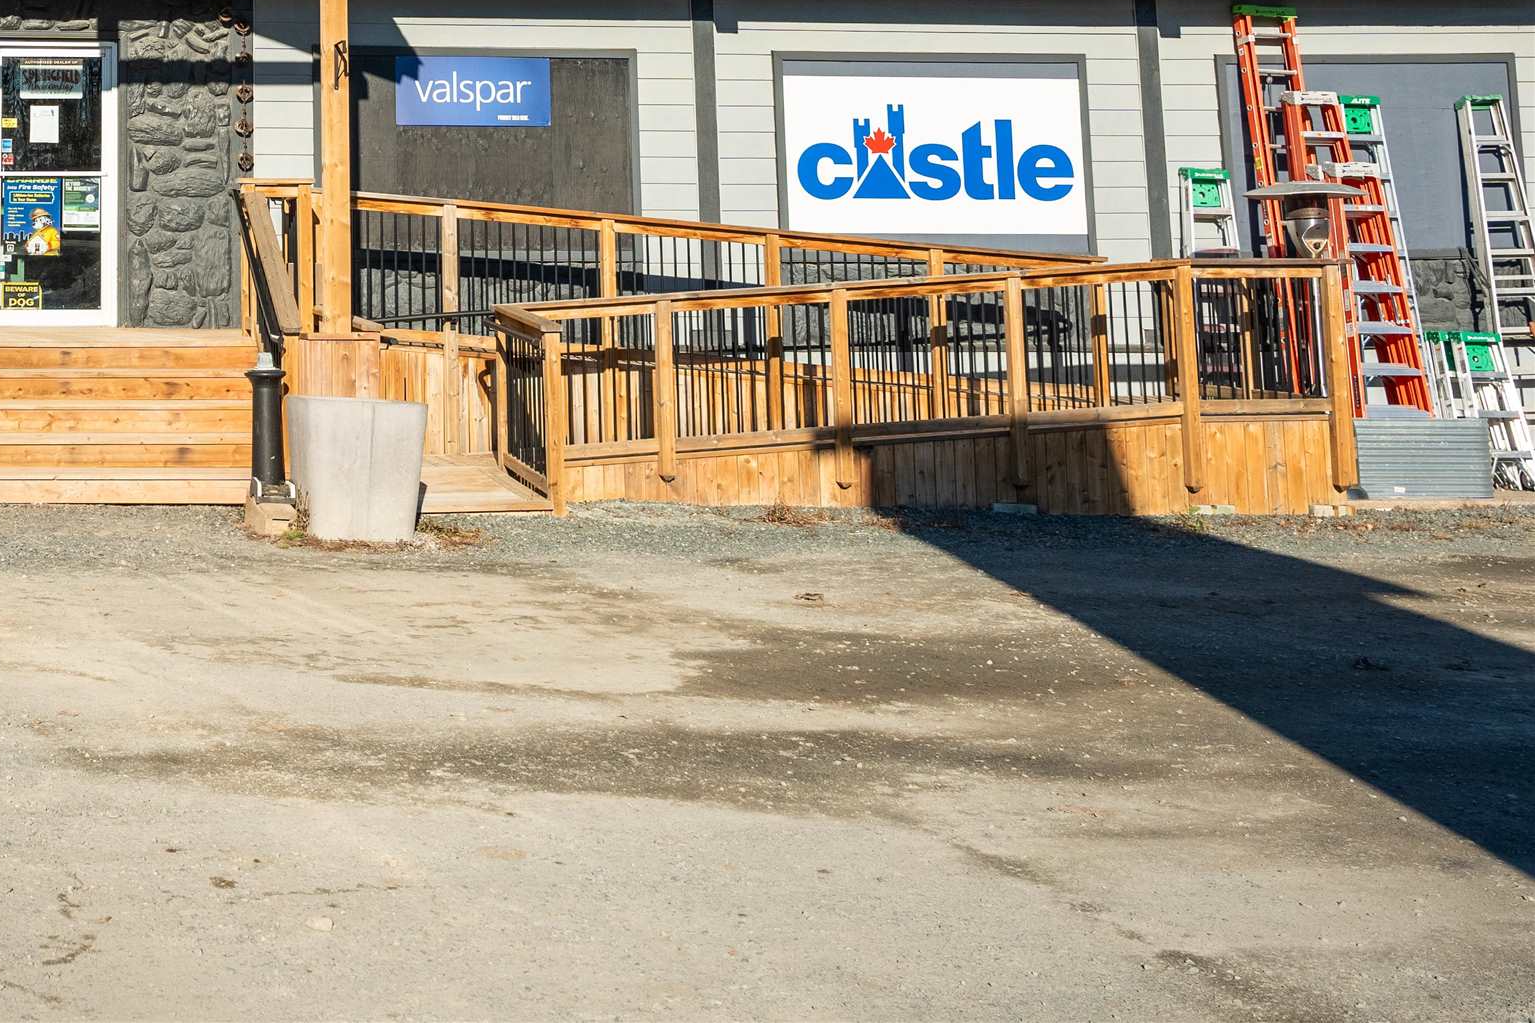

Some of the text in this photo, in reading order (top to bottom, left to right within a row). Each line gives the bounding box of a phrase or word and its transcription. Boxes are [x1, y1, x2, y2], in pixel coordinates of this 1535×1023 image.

[414, 71, 528, 111] valspar
[797, 104, 1074, 202] castle
[5, 285, 38, 293] BEWARE
[9, 297, 35, 307] DOG
